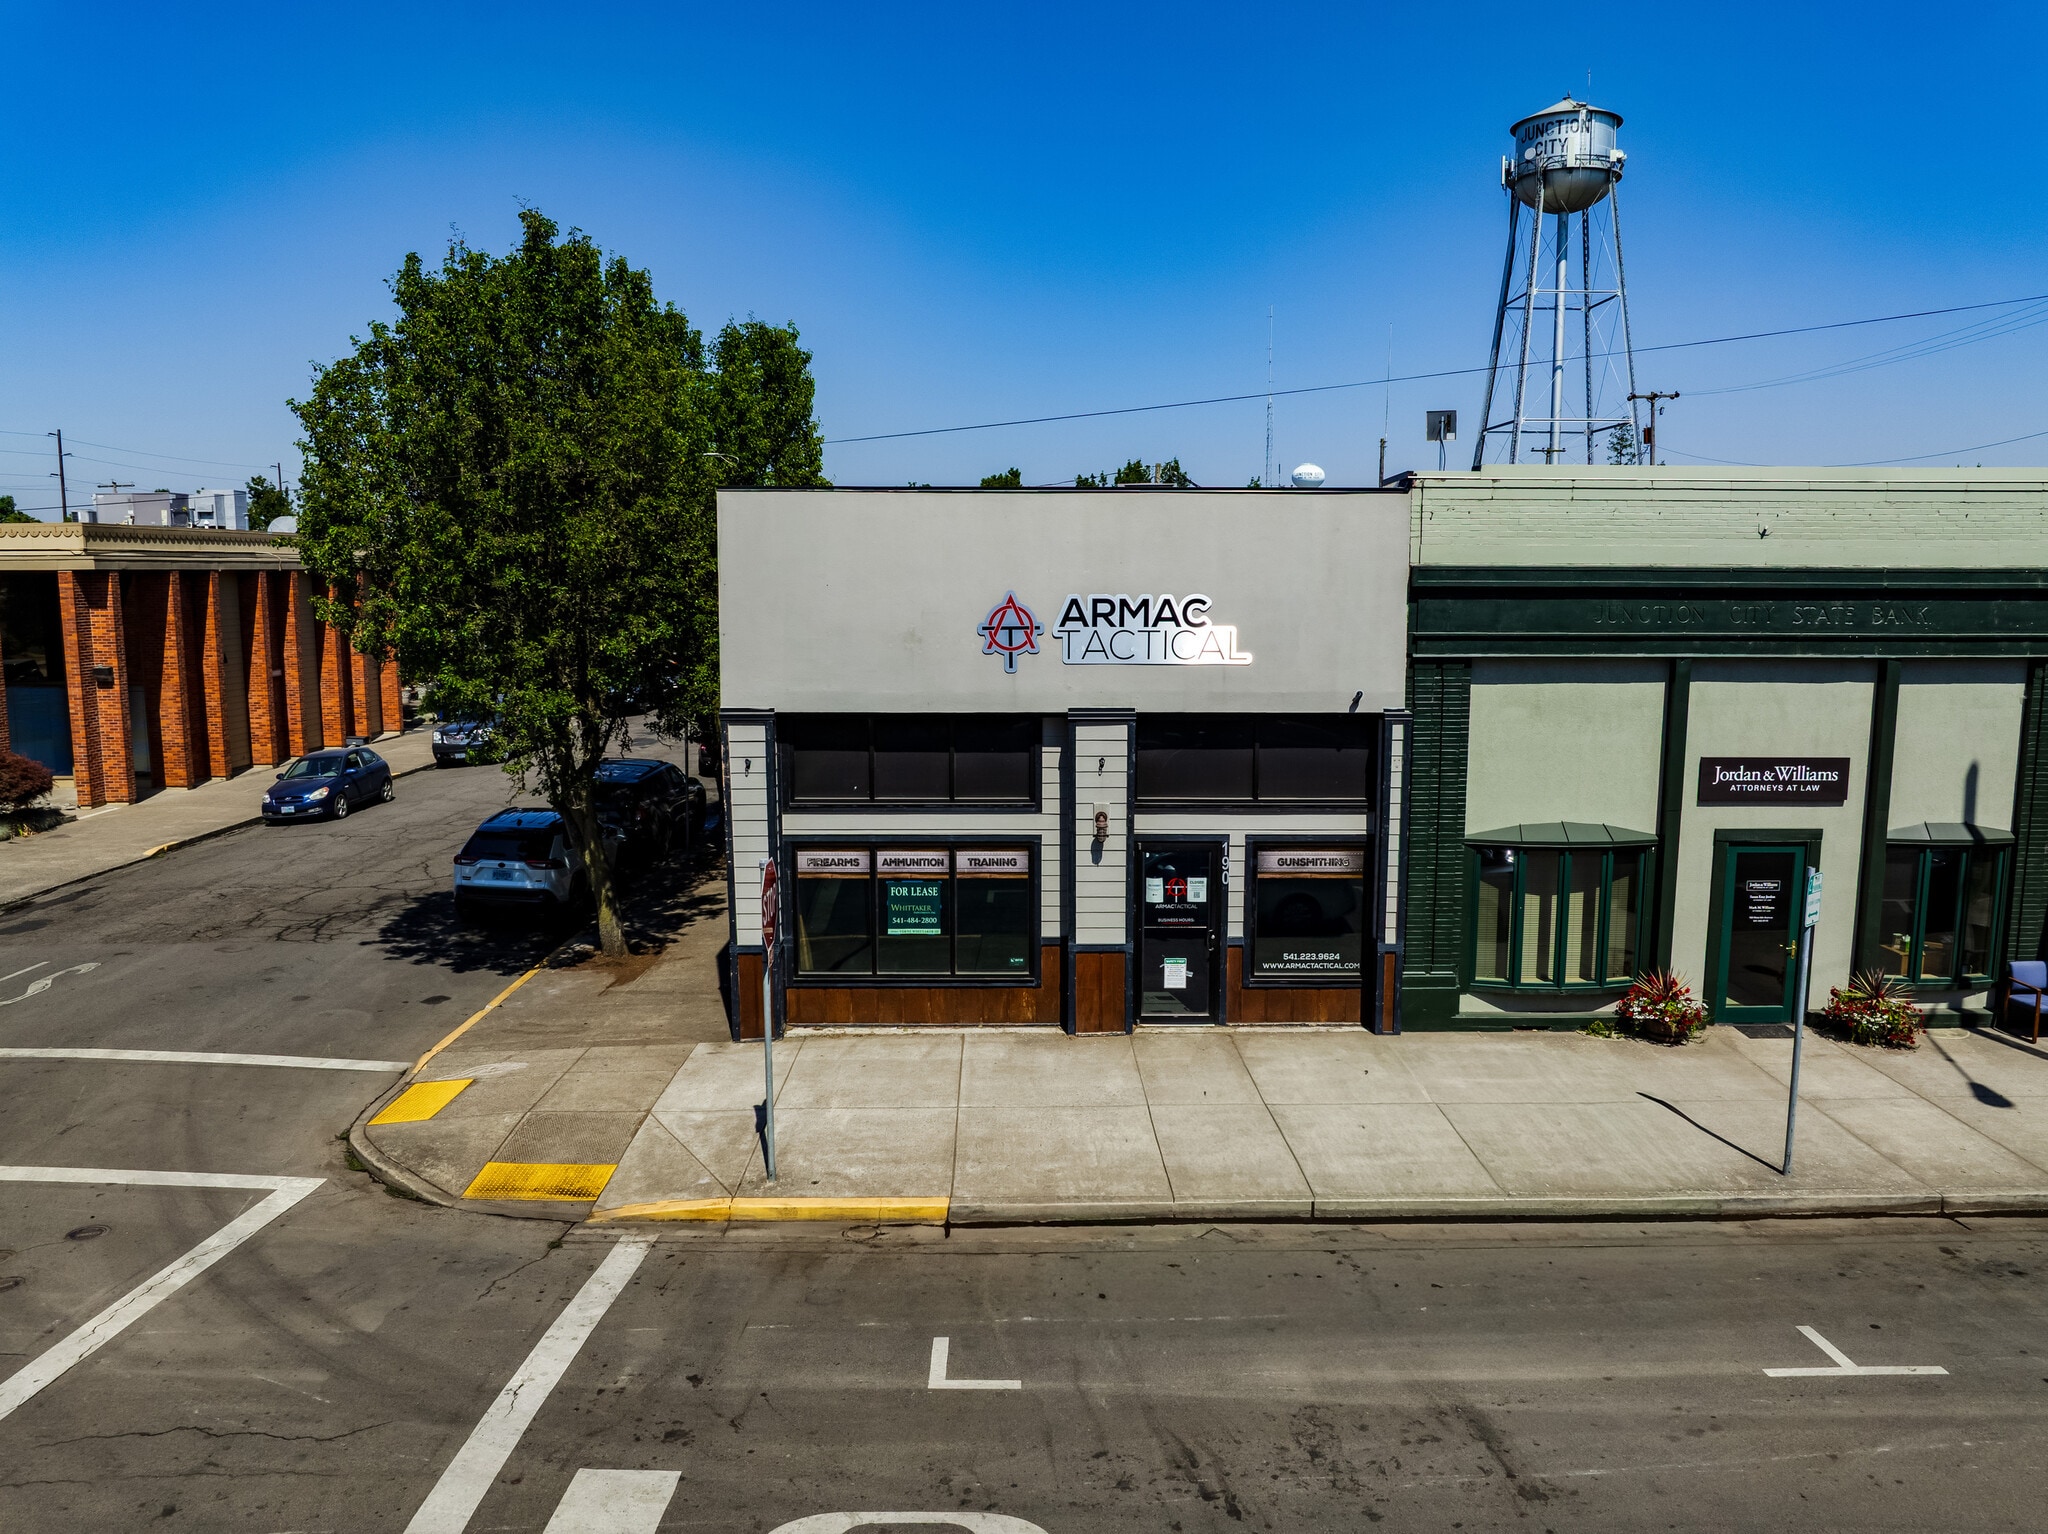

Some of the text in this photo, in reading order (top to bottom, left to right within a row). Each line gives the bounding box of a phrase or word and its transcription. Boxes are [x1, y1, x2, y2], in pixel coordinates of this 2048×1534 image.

[1521, 118, 1590, 144] JUNCTION
[1535, 137, 1568, 157] CITY
[1058, 598, 1208, 628] ARMAC
[1593, 605, 1932, 625] JUNCTION CITY STATE BANK
[1057, 630, 1248, 660] TACTICAL
[1712, 765, 1839, 785] Jordan & Williams
[807, 857, 860, 867] FIREARMS
[881, 858, 945, 867] AMMUNITION
[967, 857, 1018, 867] TRAINING
[1222, 841, 1230, 885] 190
[1277, 857, 1350, 867] GUNSMITHING
[890, 886, 939, 896] FOR LEASE
